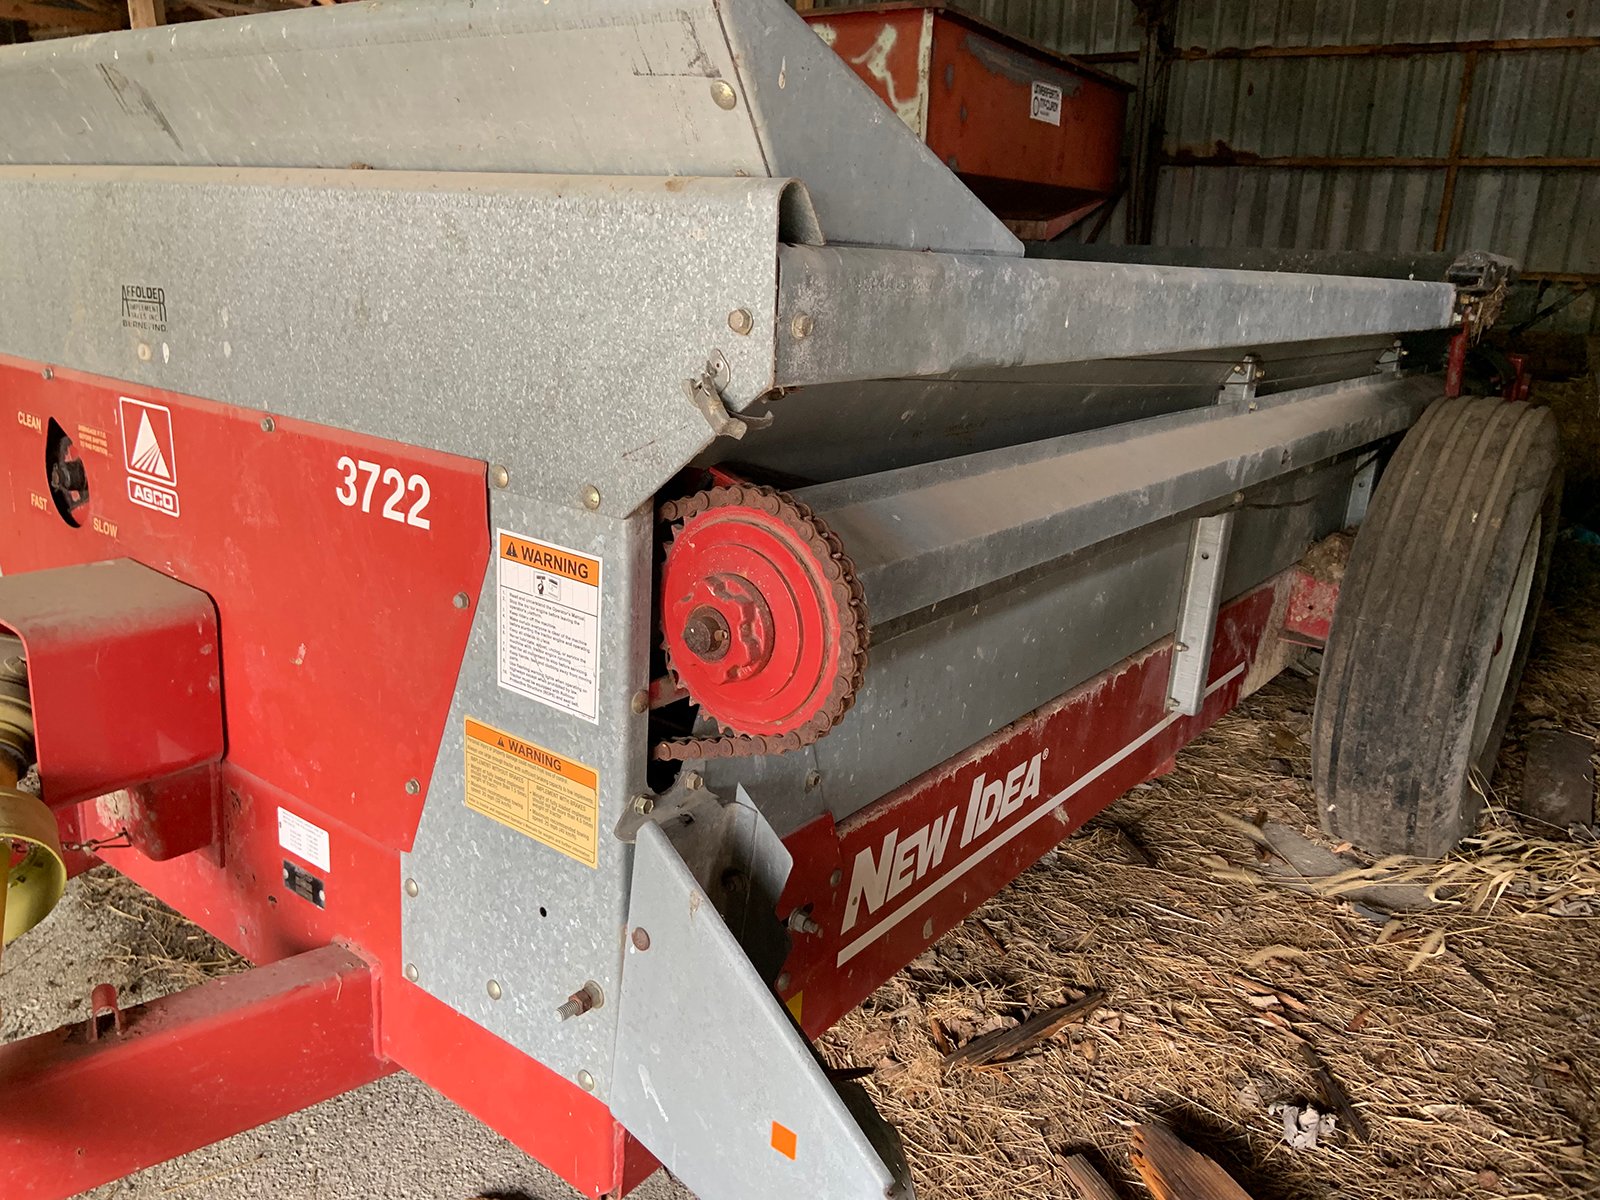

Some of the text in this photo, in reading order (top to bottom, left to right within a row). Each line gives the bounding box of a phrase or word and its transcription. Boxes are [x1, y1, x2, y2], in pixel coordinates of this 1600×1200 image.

[17, 411, 42, 432] CLEAN
[30, 493, 48, 512] FAST
[134, 484, 174, 510] AGCO
[336, 456, 431, 530] 3722
[93, 517, 118, 538] SLOW
[521, 545, 589, 579] WARNING
[508, 740, 562, 772] WARNING
[840, 806, 958, 936] NEW
